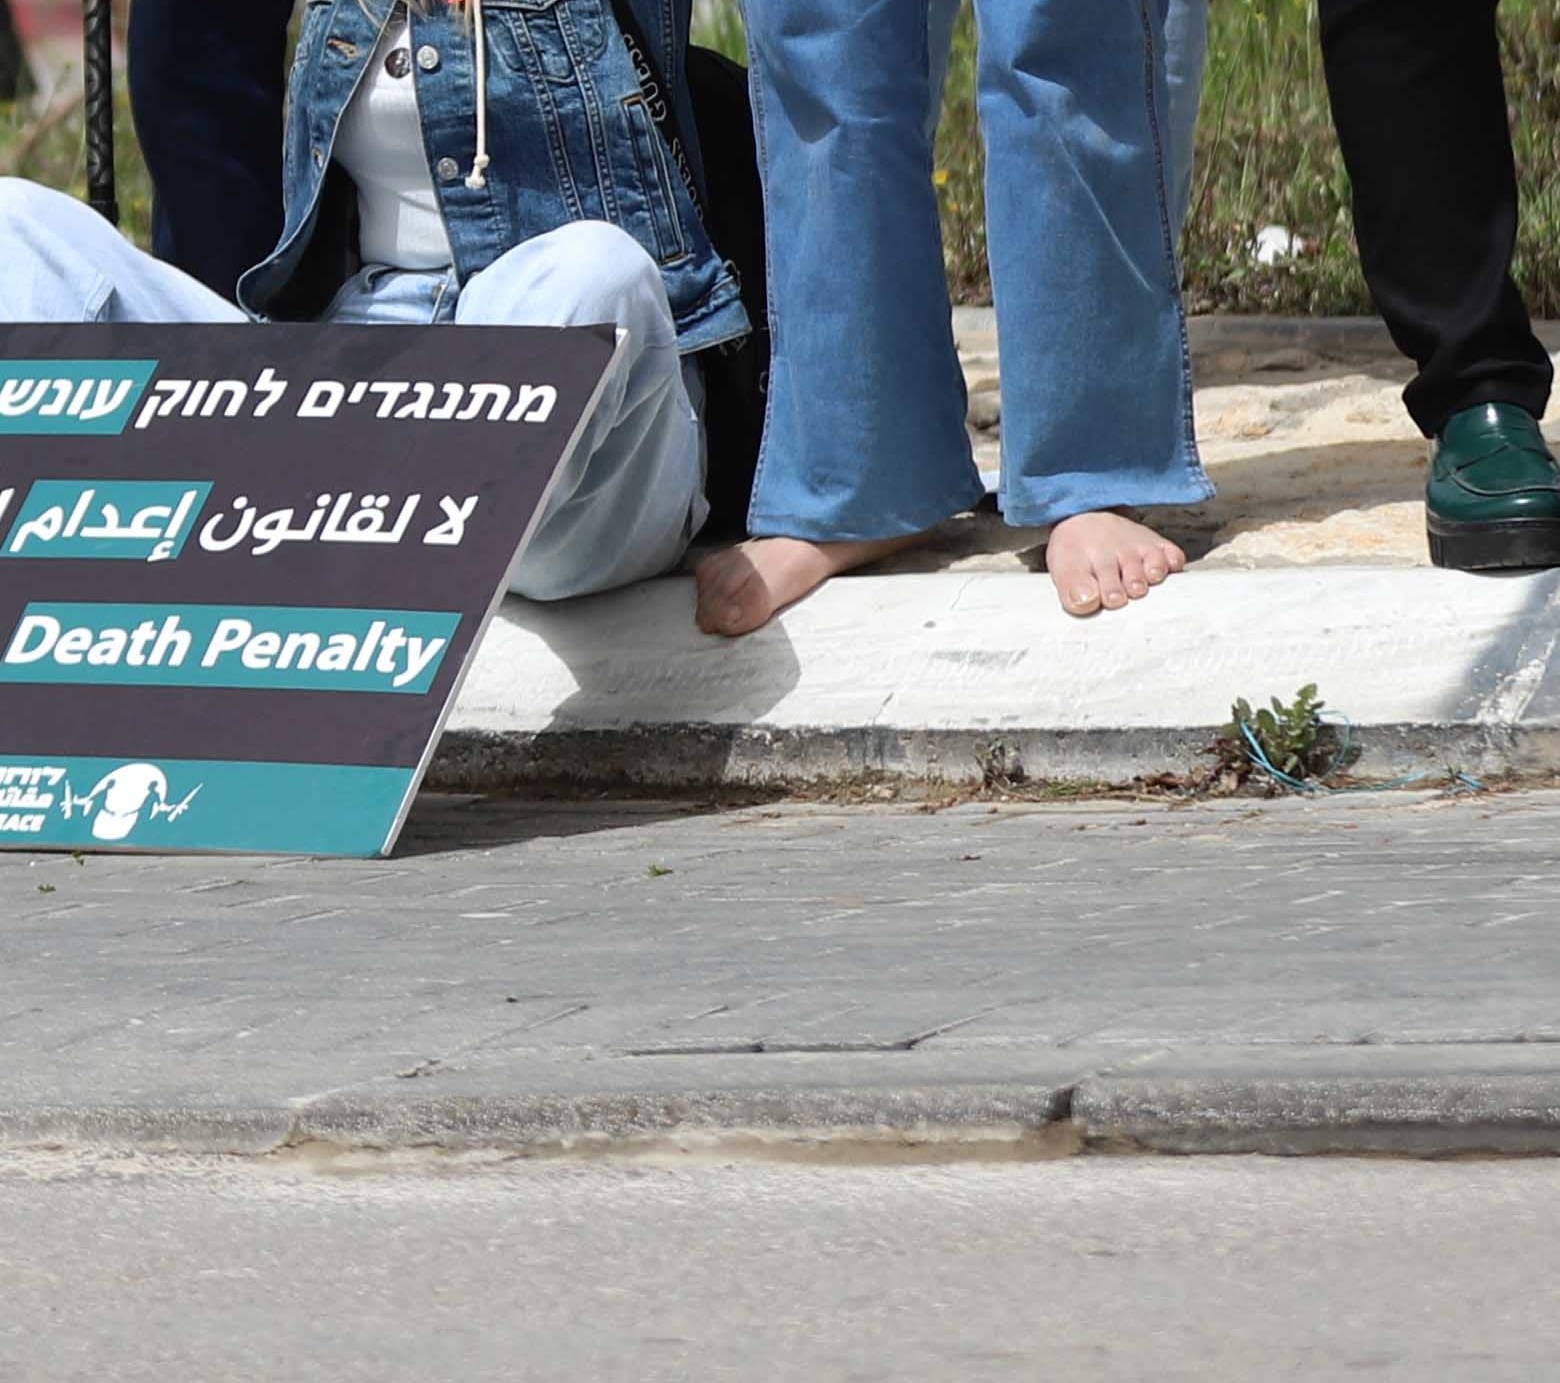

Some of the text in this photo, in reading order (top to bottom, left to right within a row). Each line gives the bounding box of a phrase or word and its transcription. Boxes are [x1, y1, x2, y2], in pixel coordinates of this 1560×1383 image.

[134, 366, 284, 427] לחוק
[296, 379, 558, 423] מתנגדים
[11, 487, 199, 562] إعدام
[200, 492, 422, 556] لقانون
[422, 495, 478, 545] لا
[7, 615, 192, 666] Death
[201, 620, 446, 687] Penalty
